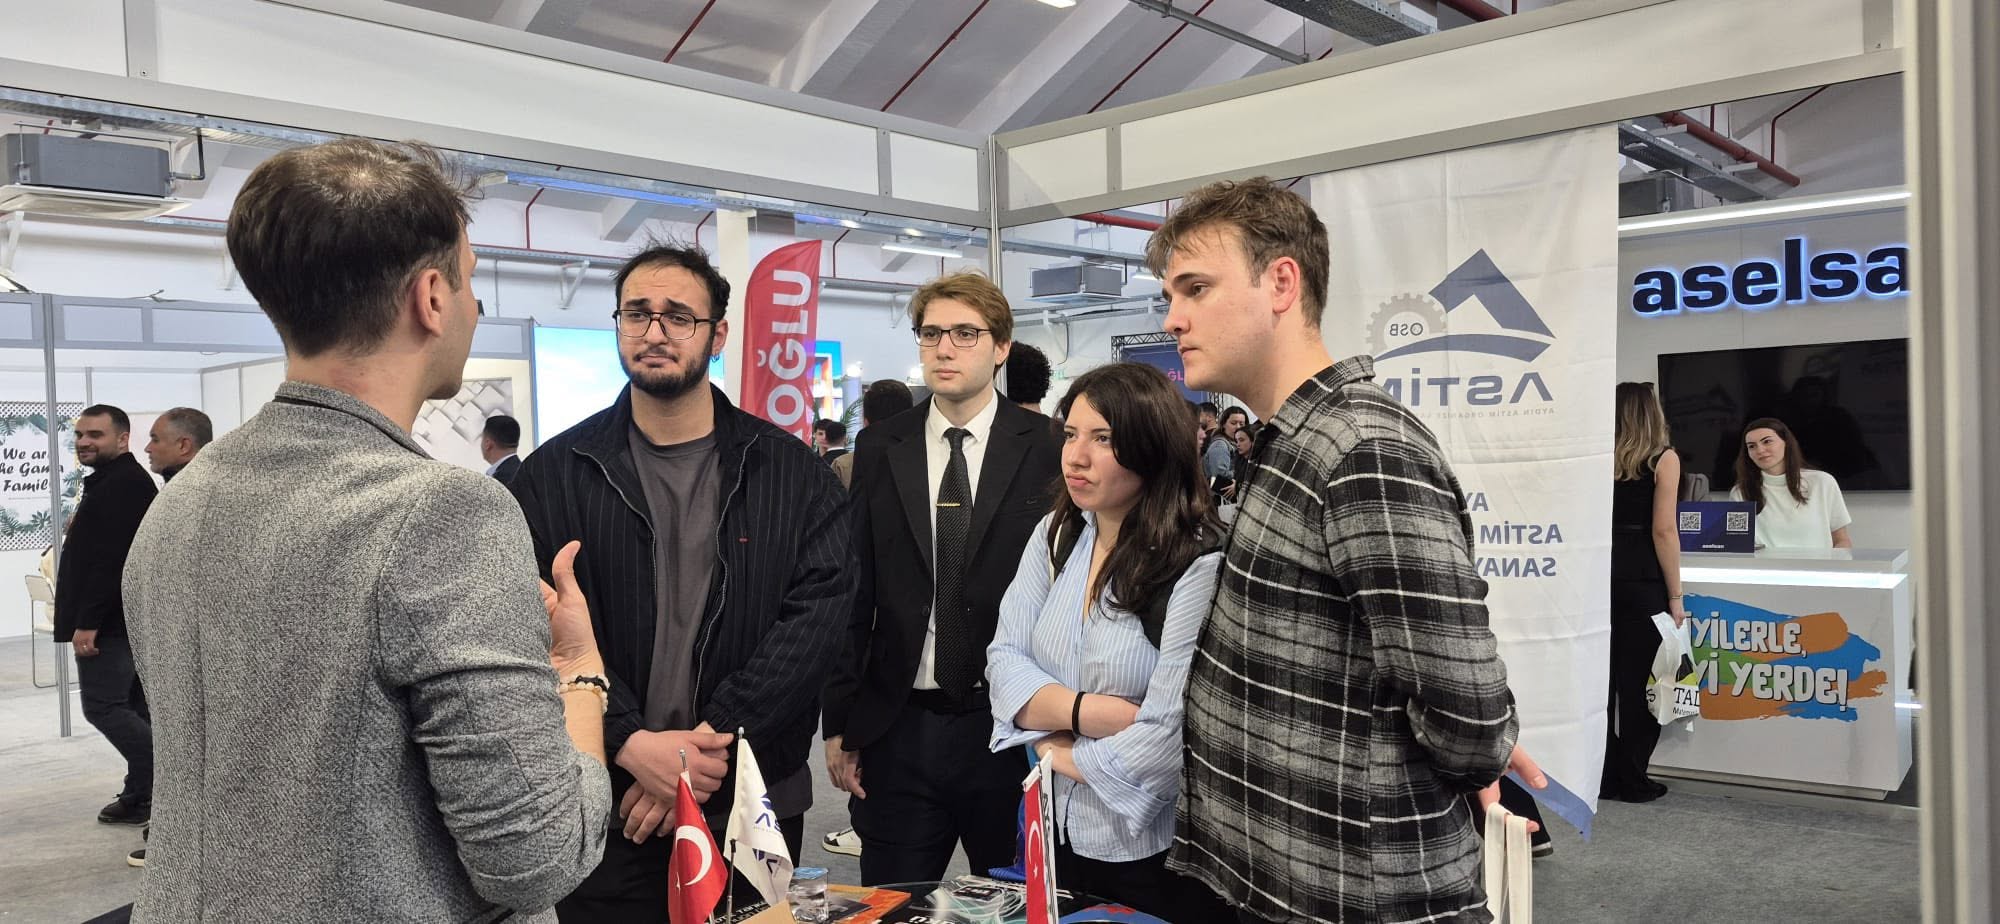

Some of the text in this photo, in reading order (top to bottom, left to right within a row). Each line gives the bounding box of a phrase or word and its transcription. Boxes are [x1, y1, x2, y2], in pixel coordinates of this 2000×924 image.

[1632, 238, 1910, 313] aselsa
[757, 269, 812, 438] OĞLU
[3, 447, 49, 460] We ar
[3, 479, 49, 492] Famil
[1728, 660, 1848, 713] YERDE!
